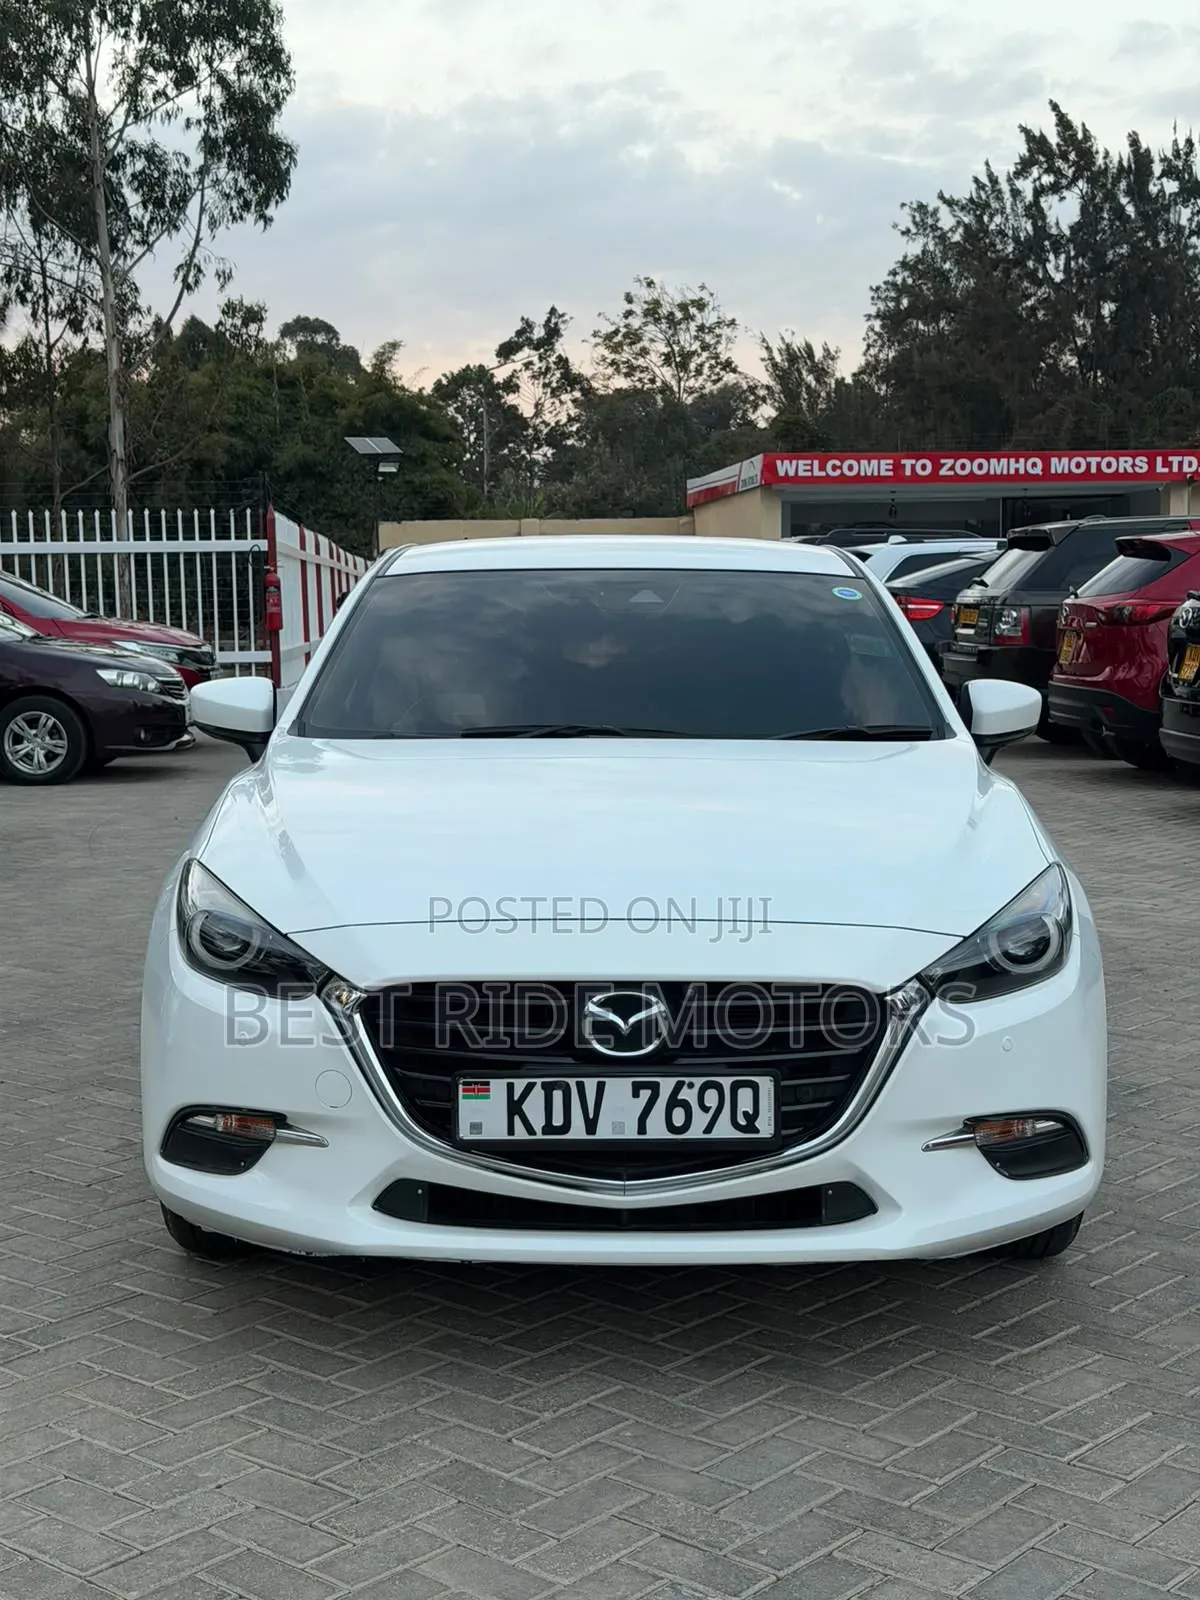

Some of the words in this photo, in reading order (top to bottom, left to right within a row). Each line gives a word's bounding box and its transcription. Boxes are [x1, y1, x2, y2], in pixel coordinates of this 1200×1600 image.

[776, 459, 894, 477] WELCOME
[901, 459, 933, 477] TO
[939, 457, 1043, 476] ZOOMHQ
[1050, 456, 1149, 475] MOTORS
[506, 1080, 606, 1136] KDV
[631, 1079, 761, 1136] 769Q
